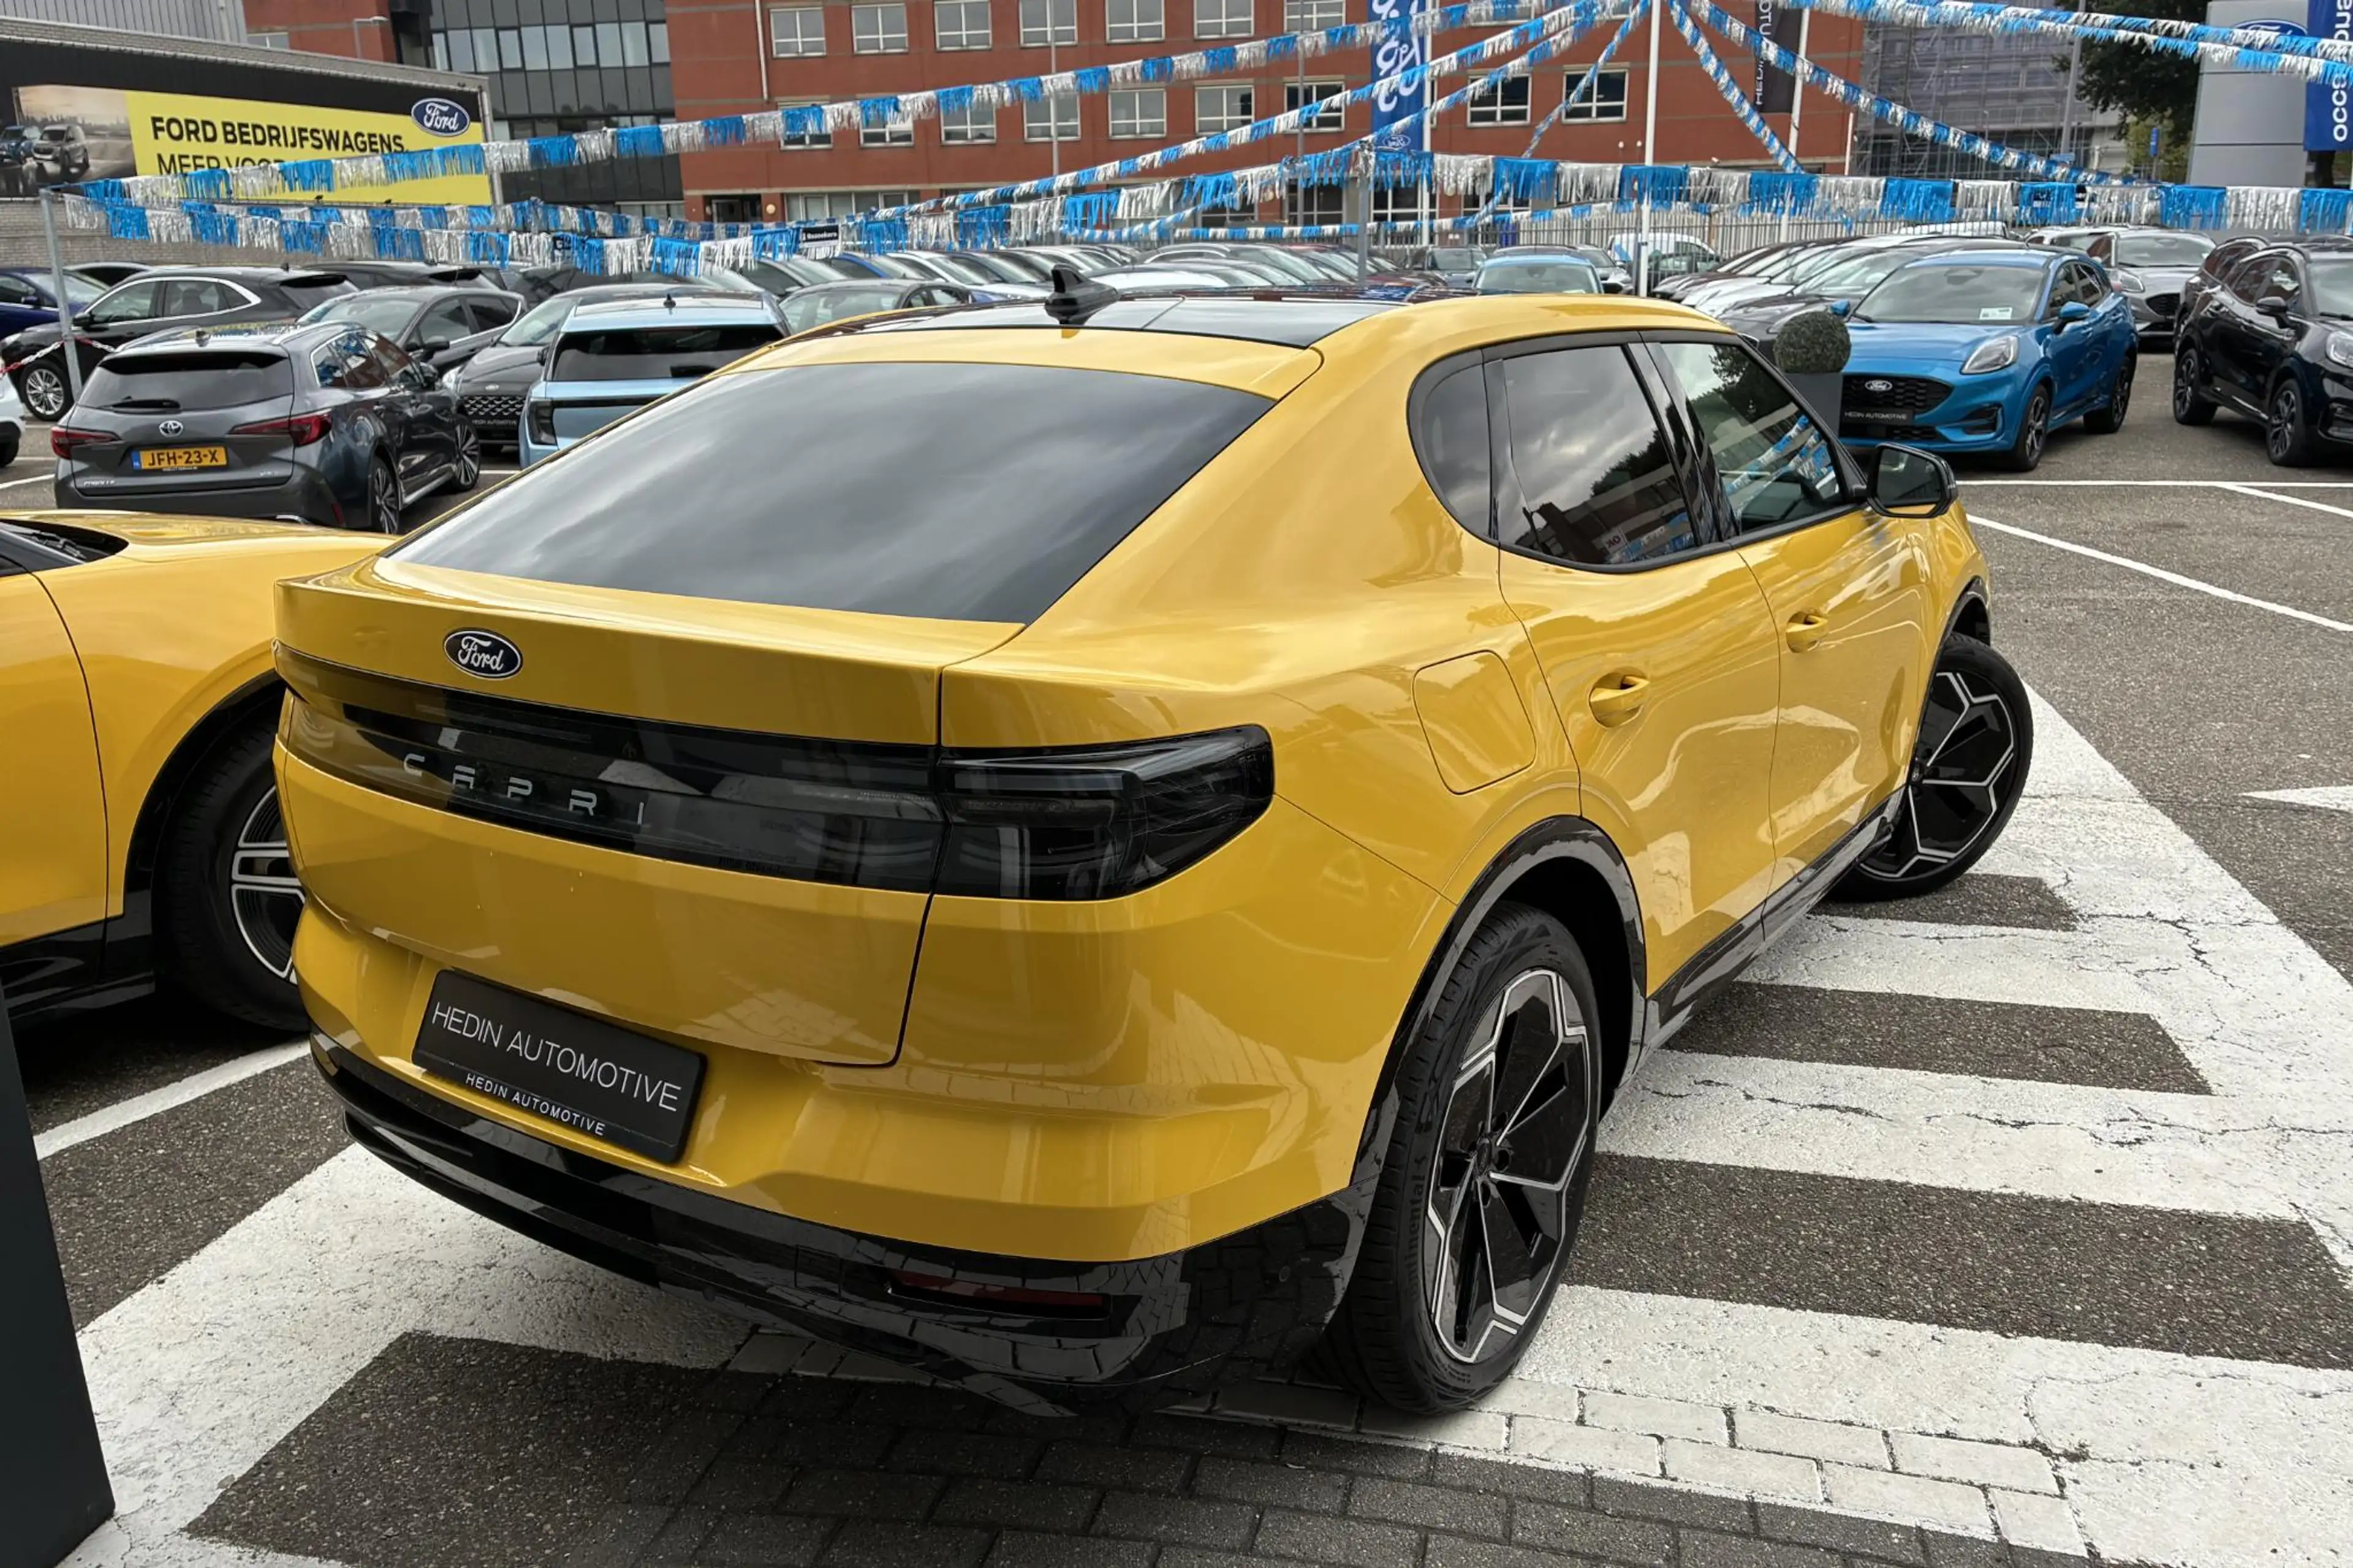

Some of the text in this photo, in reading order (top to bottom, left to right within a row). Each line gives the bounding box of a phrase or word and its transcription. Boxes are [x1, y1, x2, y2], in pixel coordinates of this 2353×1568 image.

[151, 116, 218, 143] FORD
[423, 102, 459, 131] Ford
[148, 449, 219, 466] JFH-23-X
[458, 635, 504, 671] Ford
[403, 753, 645, 825] CAPRI
[431, 1001, 681, 1112] HEDIN AUTOMOTIVE
[465, 1072, 607, 1136] HEDIN AUTOMOTIVE
